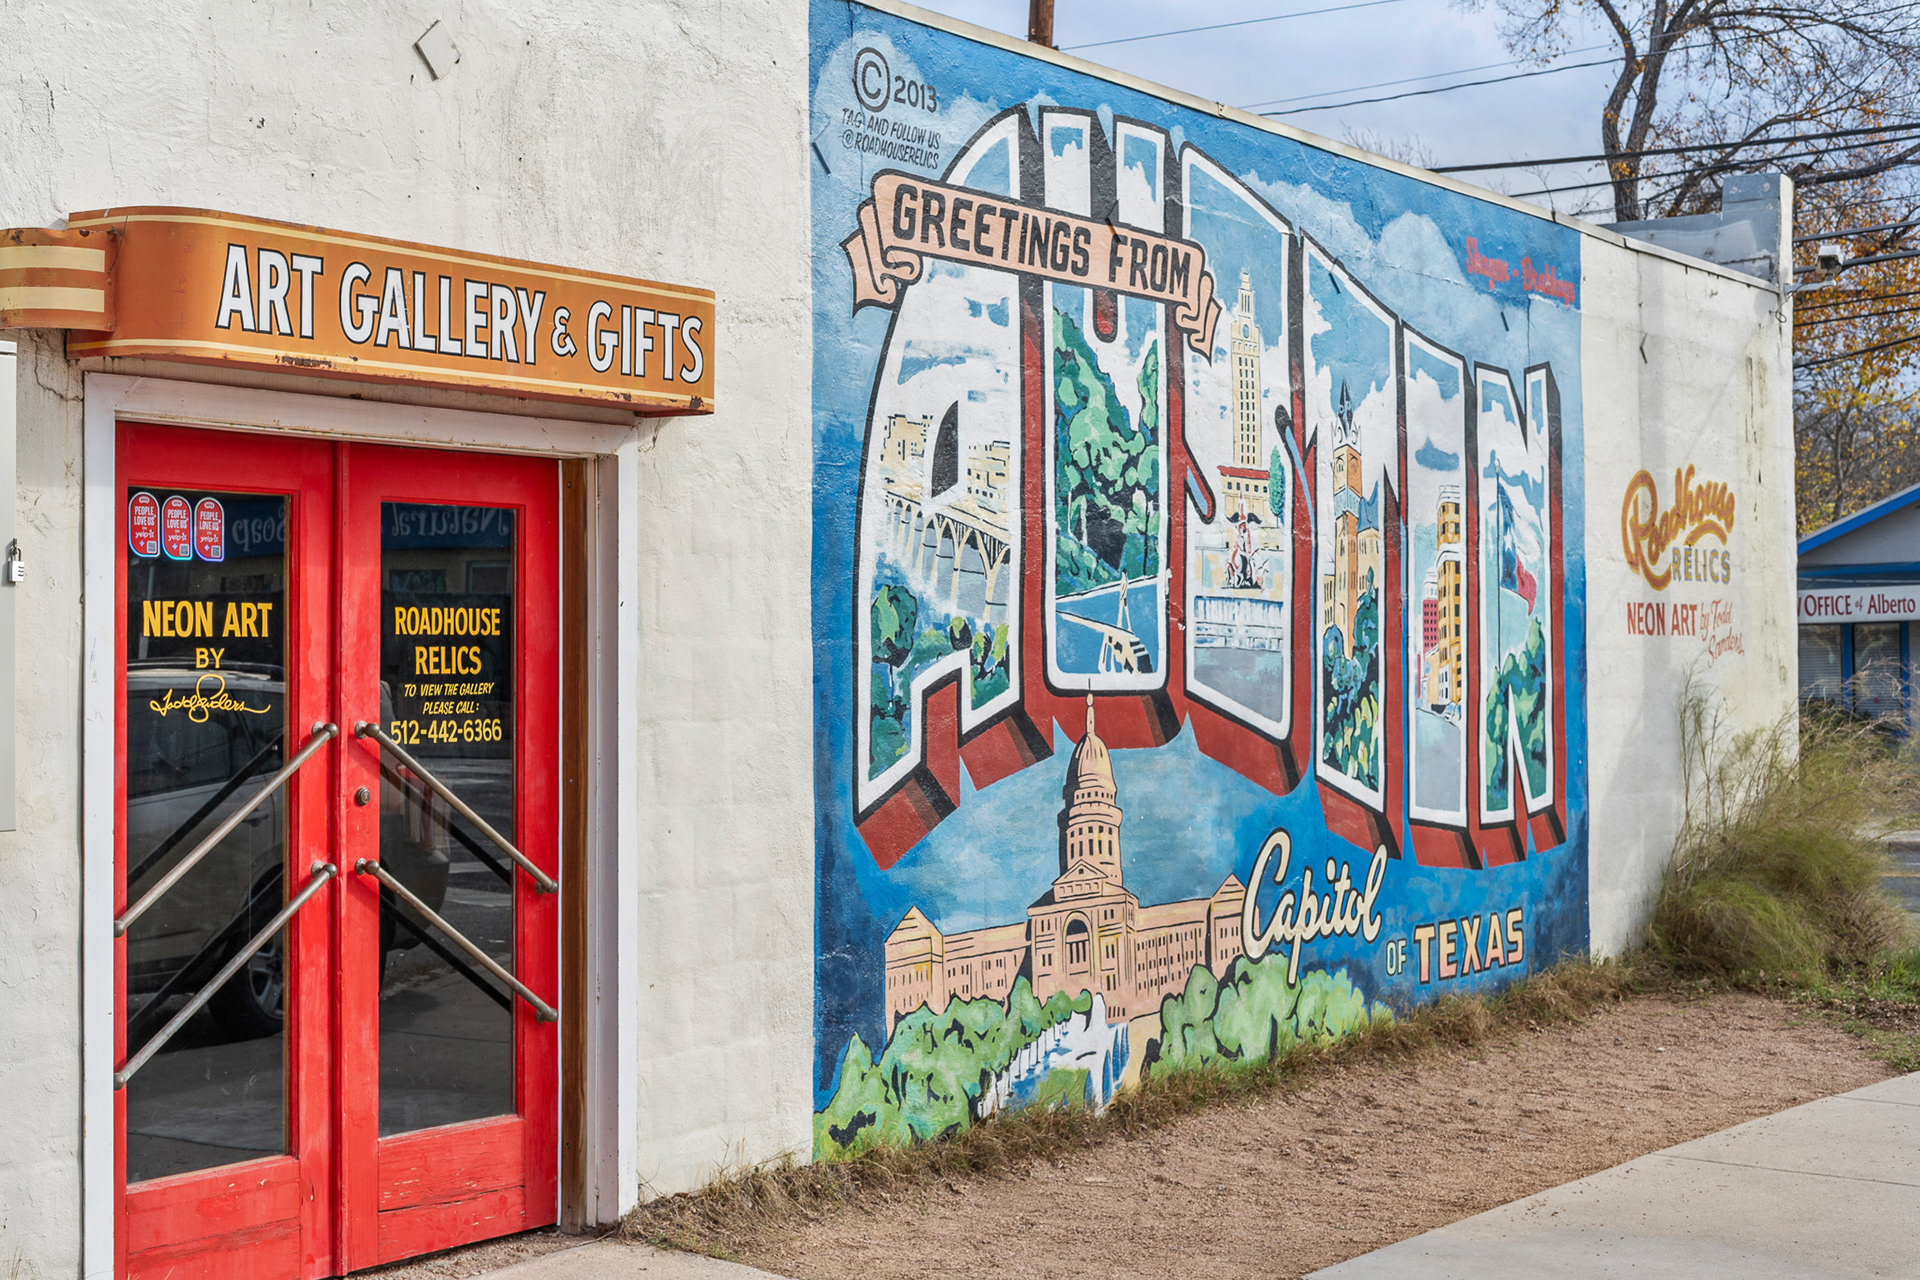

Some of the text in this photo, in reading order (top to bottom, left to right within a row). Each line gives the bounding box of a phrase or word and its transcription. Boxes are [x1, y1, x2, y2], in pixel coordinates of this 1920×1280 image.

[842, 108, 941, 150] TAG AND FOLLOW US
[841, 129, 940, 170] @ROADHOUSERELICS
[892, 183, 1191, 299] GREETINGS FROM
[215, 243, 705, 384] ART GALLERY & GIFTS
[852, 104, 1566, 868] AUSTIN
[133, 515, 155, 526] LOVE US
[134, 506, 154, 516] PEOPLE
[167, 509, 186, 519] PEOPLE
[167, 519, 187, 529] LOVE US
[200, 511, 218, 521] PEOPLE
[135, 531, 148, 539] yelp
[199, 521, 219, 531] LOVE US
[1621, 464, 1735, 591] Roadhouse
[1672, 547, 1731, 585] RELICS
[142, 600, 273, 637] NEON ART
[1804, 594, 1852, 616] OFFICE
[1855, 596, 1864, 612] of
[1867, 593, 1916, 614] Alberto
[394, 606, 500, 636] ROADHOUSE
[1627, 598, 1733, 642] NEON ART by Todd
[195, 647, 225, 669] BY
[414, 646, 482, 675] RELICS
[1707, 626, 1745, 668] Sanders
[404, 682, 494, 697] TO VIEW THE GALLERY
[422, 701, 480, 715] PLEASE CALL:
[390, 718, 502, 745] 512-442-6366
[1241, 827, 1388, 989] Capitol
[1386, 908, 1524, 985] OF TEXAS
